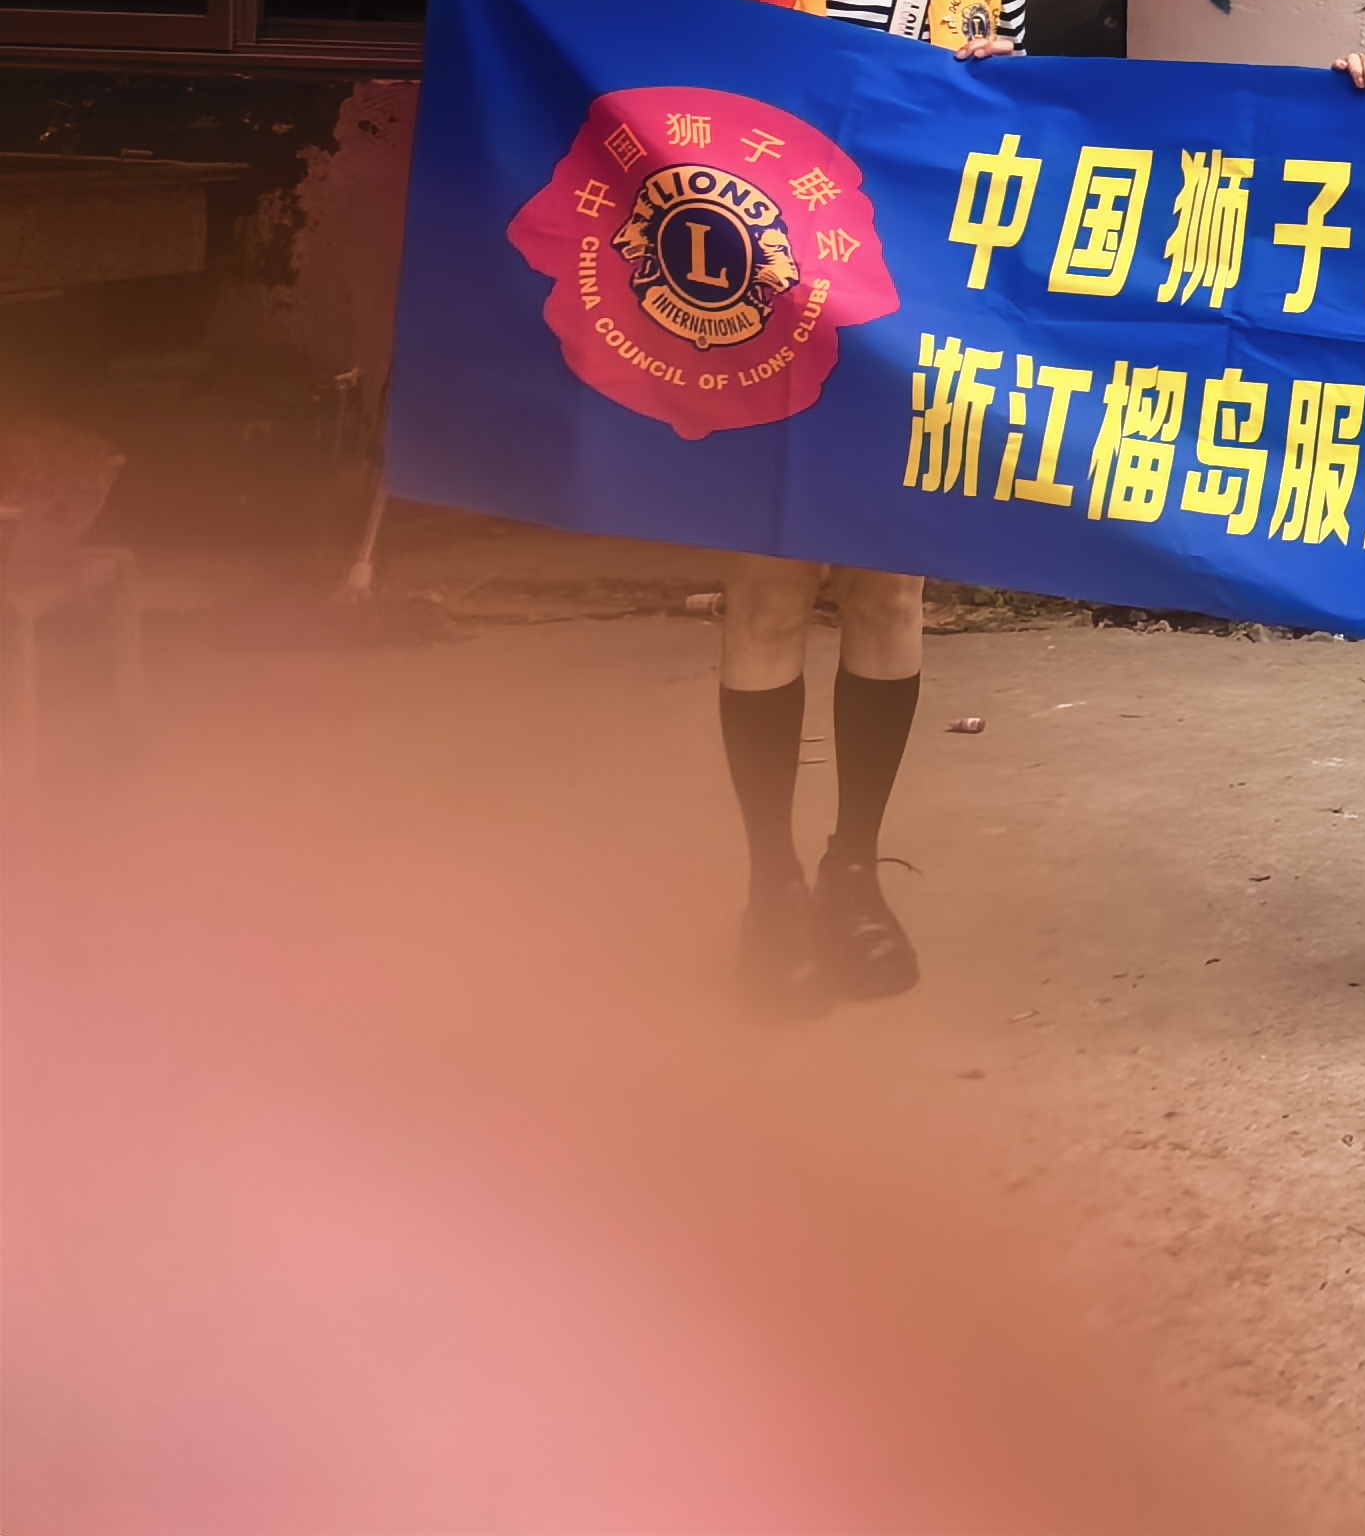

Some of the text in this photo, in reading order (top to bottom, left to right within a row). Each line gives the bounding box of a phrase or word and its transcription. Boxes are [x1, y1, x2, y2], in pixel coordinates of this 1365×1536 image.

[574, 113, 860, 263] 中国狮子联会
[655, 172, 770, 220] LIONS
[686, 222, 729, 288] L
[578, 236, 831, 390] CHINA COUNCIL OF LIONS CLUBS
[652, 293, 754, 337] INTERNATIONAL
